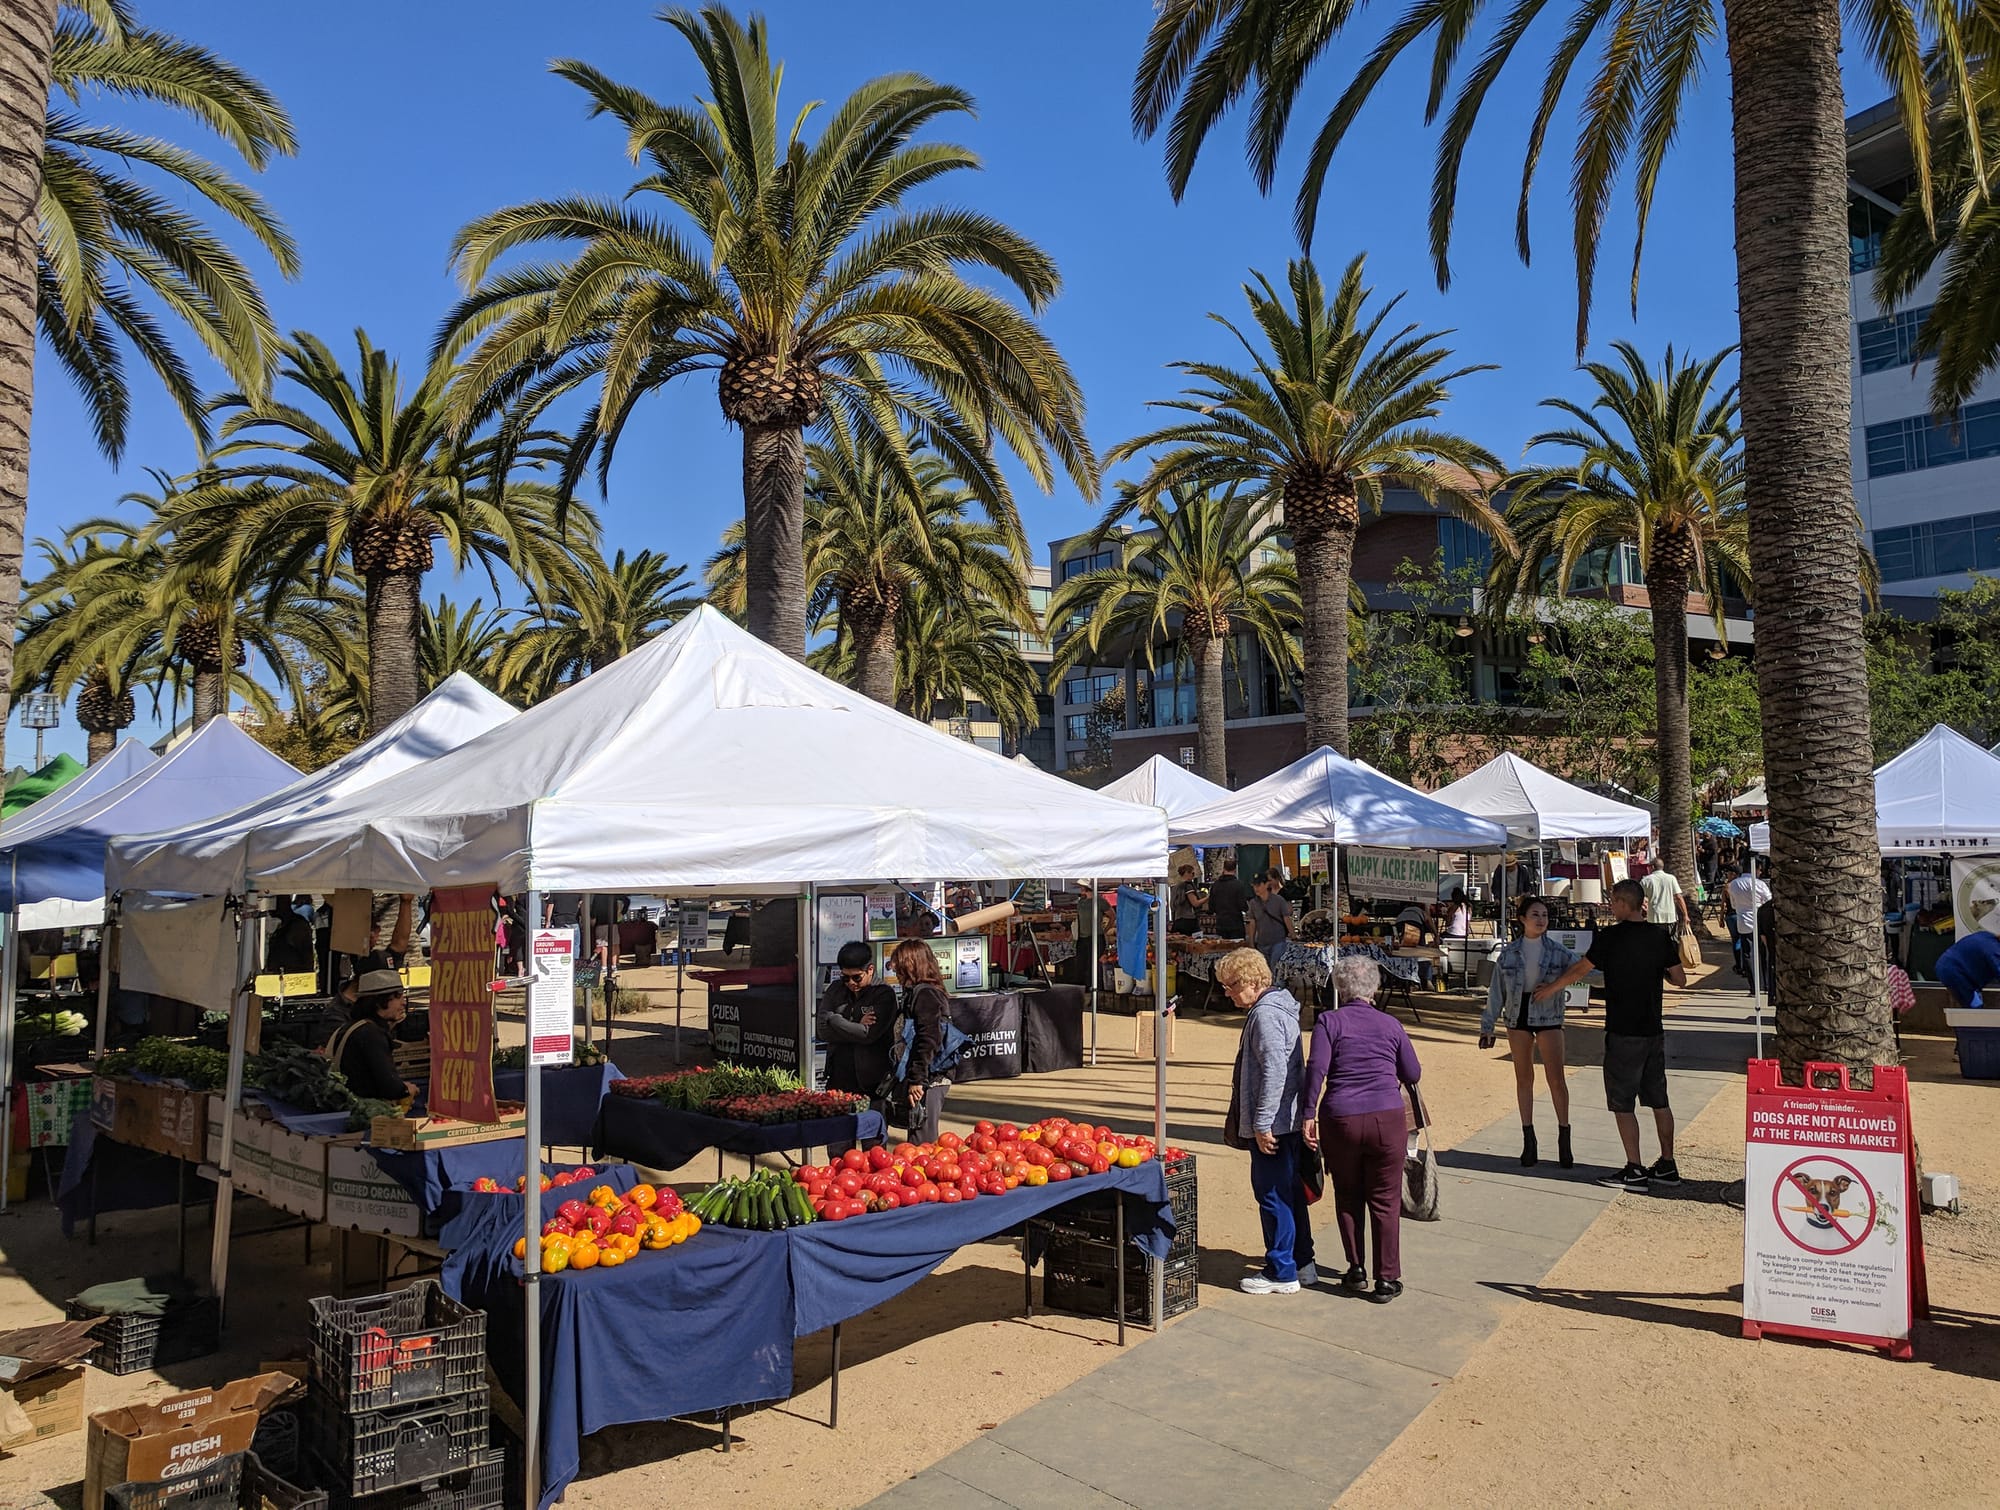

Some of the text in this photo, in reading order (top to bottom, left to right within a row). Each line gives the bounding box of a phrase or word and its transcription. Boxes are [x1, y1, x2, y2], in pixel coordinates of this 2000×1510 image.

[1348, 856, 1437, 882] HAPPY ACRE FARM
[712, 1004, 740, 1021] CUESA
[441, 1009, 481, 1053] SOLD
[974, 1033, 980, 1042] A
[981, 1030, 1016, 1042] HEALTHY
[743, 1043, 766, 1057] FOOD
[963, 1042, 1017, 1059] SYSTEM
[441, 1057, 475, 1104] HERE
[1783, 1100, 1789, 1109] A
[1790, 1101, 1819, 1112] friendly
[447, 1122, 512, 1137] CERTIFIED ORGANIC
[1753, 1111, 1896, 1132] DOGS ARE NOT ALLOWED
[1752, 1127, 1897, 1148] AT THE FARMERS MARKET
[332, 1183, 369, 1198] CERTIFIED
[1756, 1251, 1776, 1259] Please
[1762, 1259, 1771, 1267] by
[1772, 1261, 1797, 1270] keeping
[1853, 1271, 1870, 1279] away
[1767, 1288, 1790, 1297] Service
[1828, 1296, 1849, 1304] always
[1810, 1306, 1836, 1317] CUESA
[161, 1394, 213, 1415] REFRIGERATED
[178, 1408, 196, 1420] KEEP
[169, 1434, 222, 1460] FRESH
